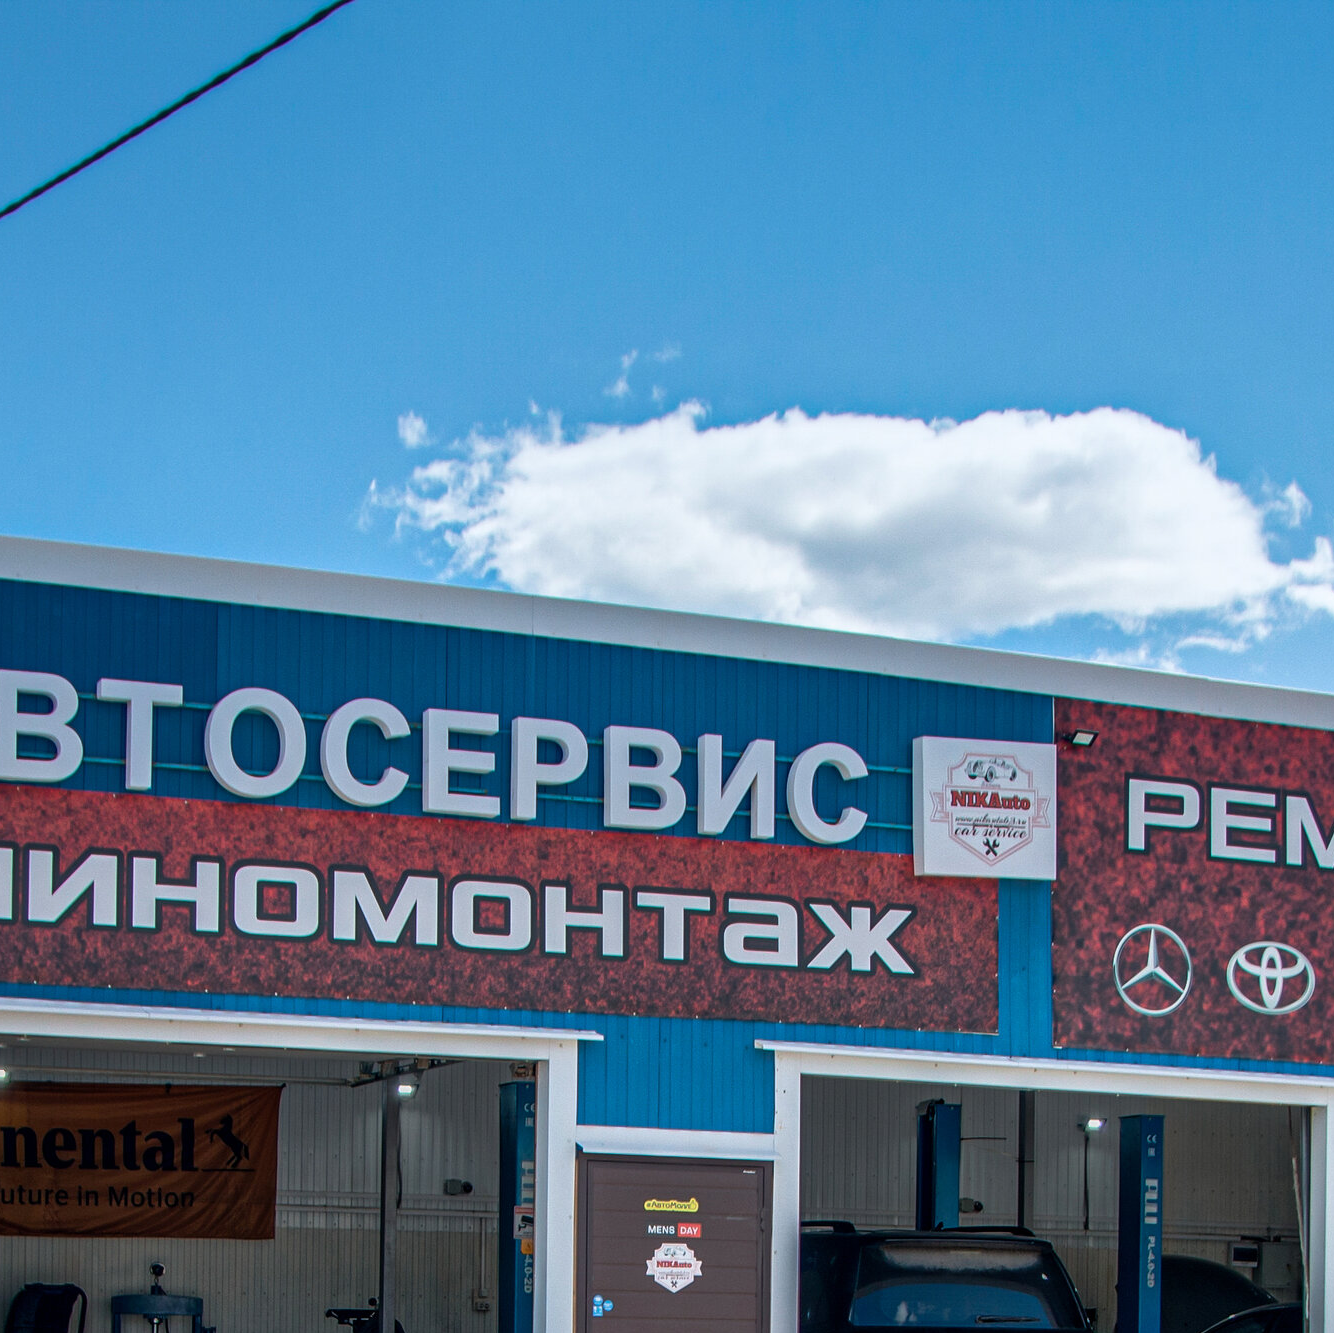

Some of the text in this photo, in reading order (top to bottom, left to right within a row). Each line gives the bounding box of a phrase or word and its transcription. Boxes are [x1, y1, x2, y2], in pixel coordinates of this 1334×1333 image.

[951, 790, 1030, 810] NIKAuto
[955, 825, 1028, 839] car service
[77, 1185, 99, 1206] in
[108, 1185, 195, 1209] Motion
[648, 1225, 698, 1236] MENS DAY
[657, 1260, 692, 1268] NIKAuto
